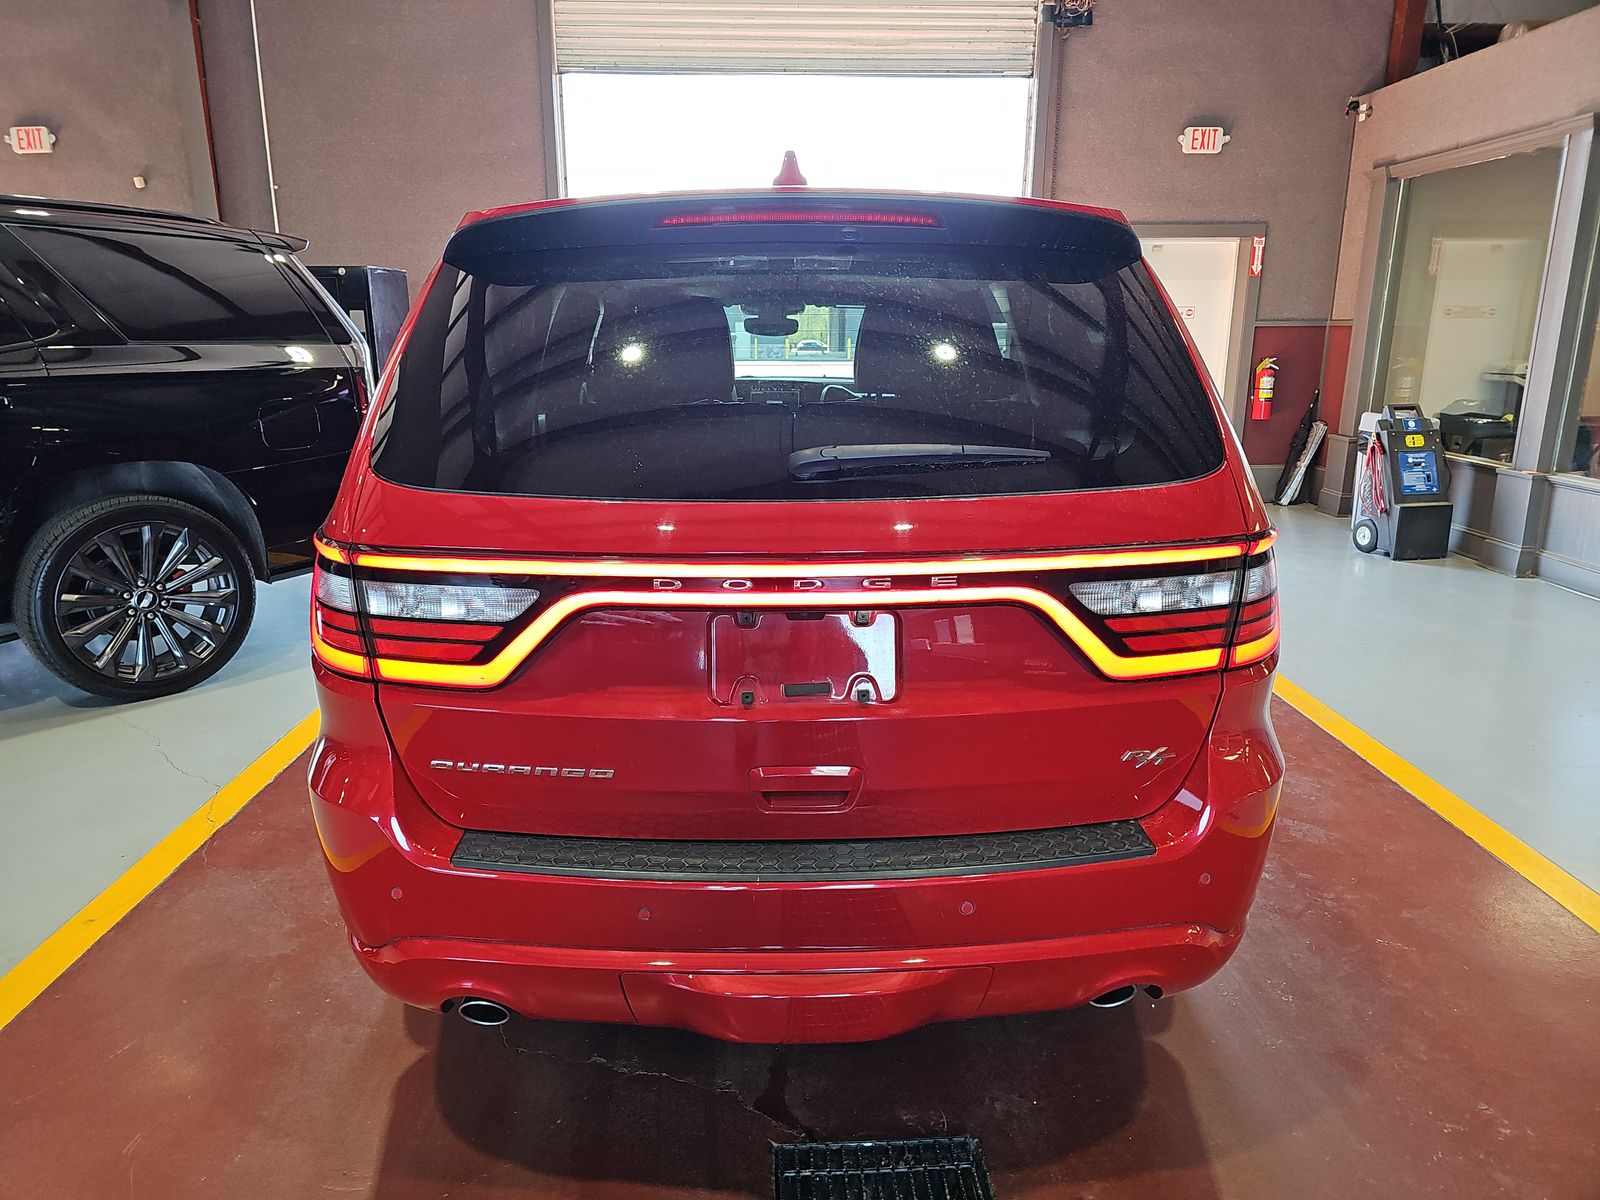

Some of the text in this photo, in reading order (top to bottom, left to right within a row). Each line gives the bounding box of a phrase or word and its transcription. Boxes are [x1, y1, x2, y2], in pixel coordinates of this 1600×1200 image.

[16, 128, 43, 150] EXIT
[1191, 128, 1219, 150] EXIT
[653, 575, 958, 591] DODGE
[1120, 746, 1177, 769] R/T
[429, 760, 615, 779] DURANGO
